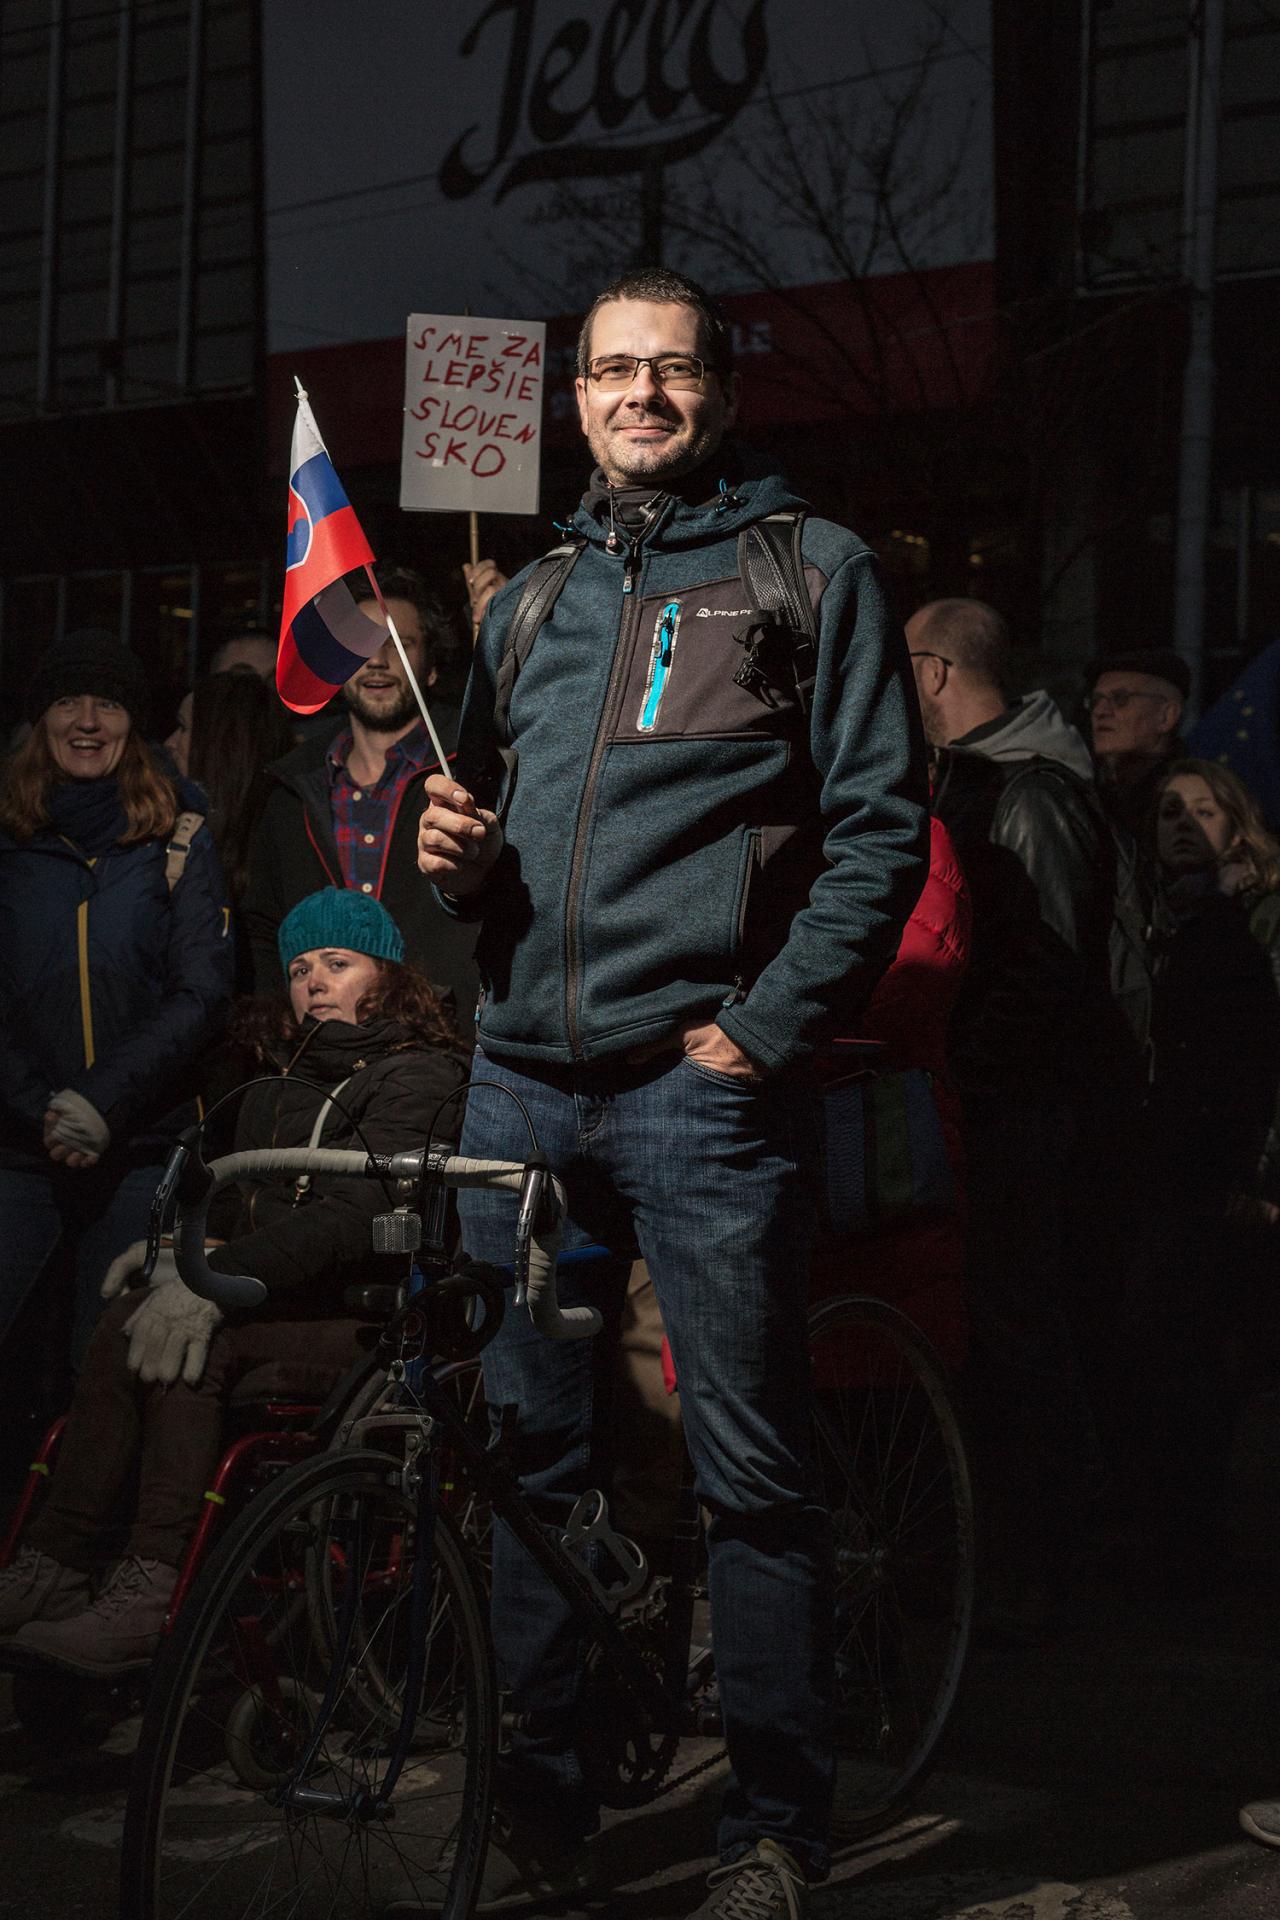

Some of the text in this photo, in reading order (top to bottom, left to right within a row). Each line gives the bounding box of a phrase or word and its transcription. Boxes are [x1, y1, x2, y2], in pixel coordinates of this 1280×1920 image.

[414, 328, 489, 359] SME
[502, 336, 540, 367] ZA
[424, 359, 539, 400] LEPŠIE
[411, 397, 536, 444] SLOVEN
[416, 432, 506, 477] SKO
[696, 607, 739, 618] ALPINE
